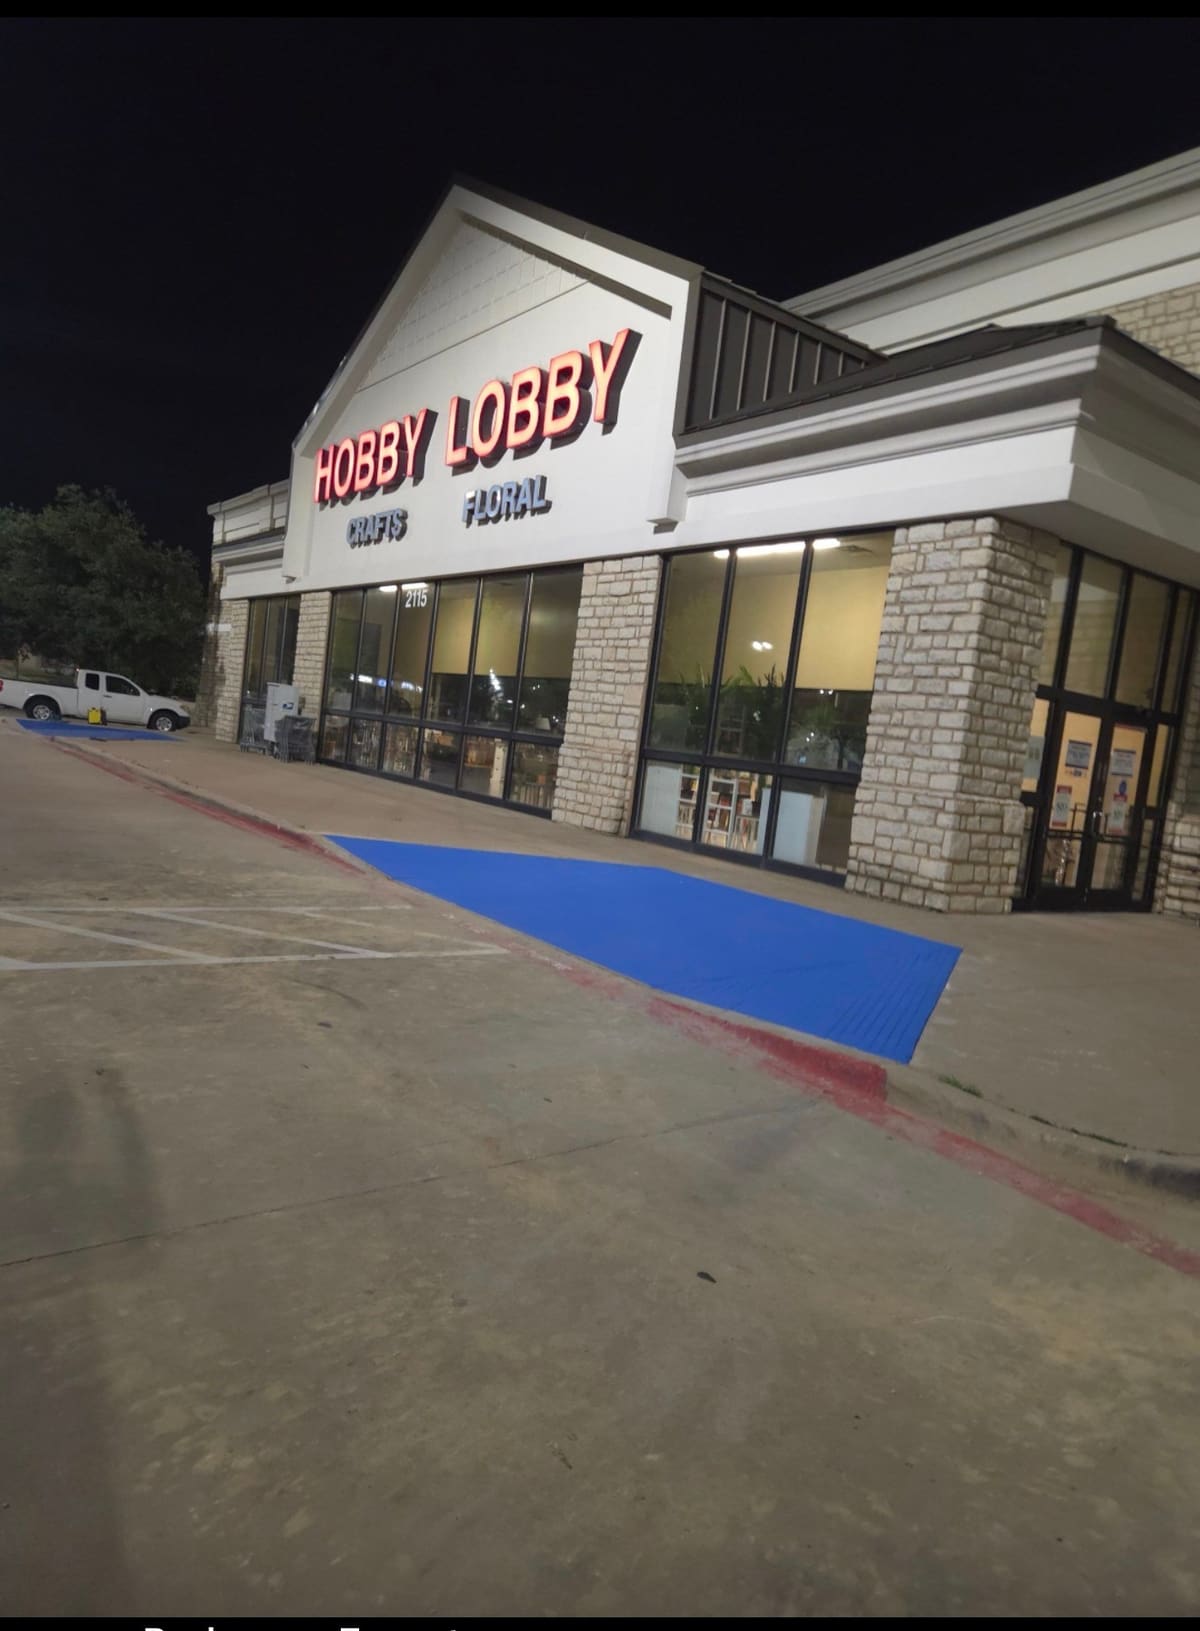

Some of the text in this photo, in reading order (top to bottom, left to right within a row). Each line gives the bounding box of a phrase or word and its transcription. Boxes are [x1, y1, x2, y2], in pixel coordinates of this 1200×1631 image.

[314, 327, 636, 504] HOBBY LOBBY
[462, 474, 550, 525] FLORAL
[347, 509, 406, 546] CRAFTS
[405, 591, 428, 608] 2115
